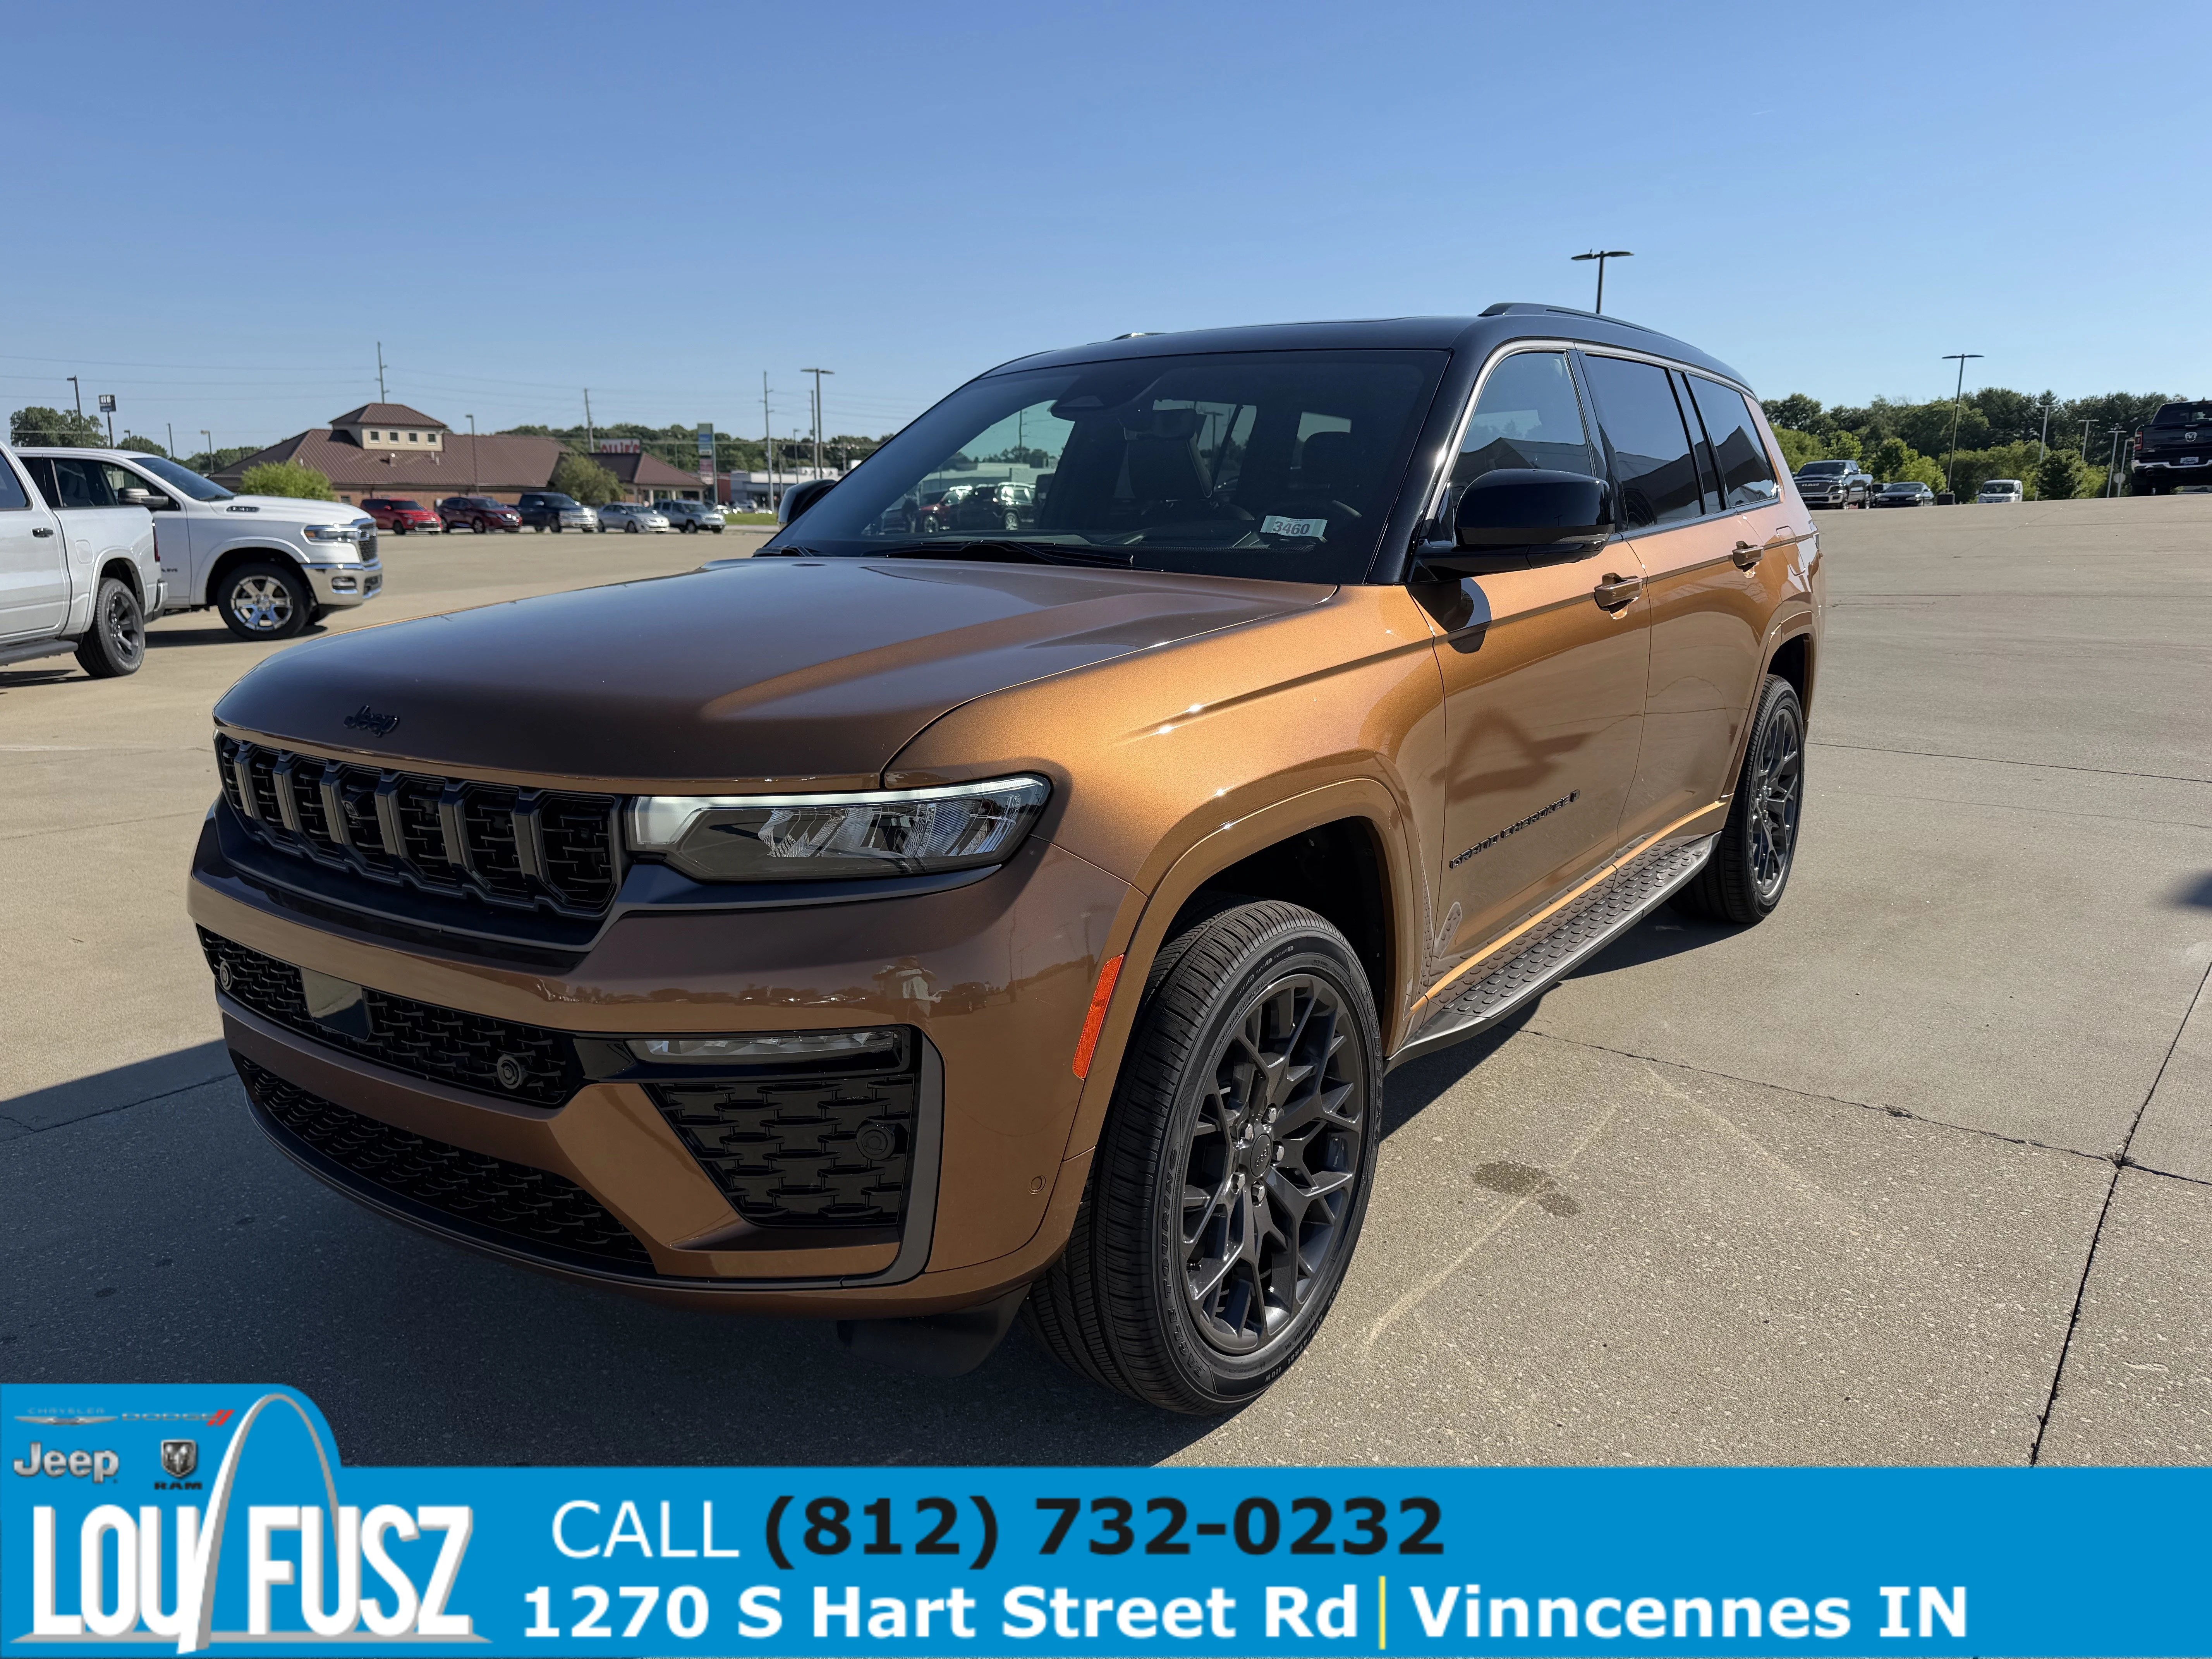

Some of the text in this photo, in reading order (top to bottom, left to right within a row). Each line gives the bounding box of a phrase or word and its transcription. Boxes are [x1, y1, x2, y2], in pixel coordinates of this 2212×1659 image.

[1273, 521, 1310, 535] 3460
[343, 704, 400, 738] Jeep
[1161, 1149, 1204, 1378] EAGLE TOURING
